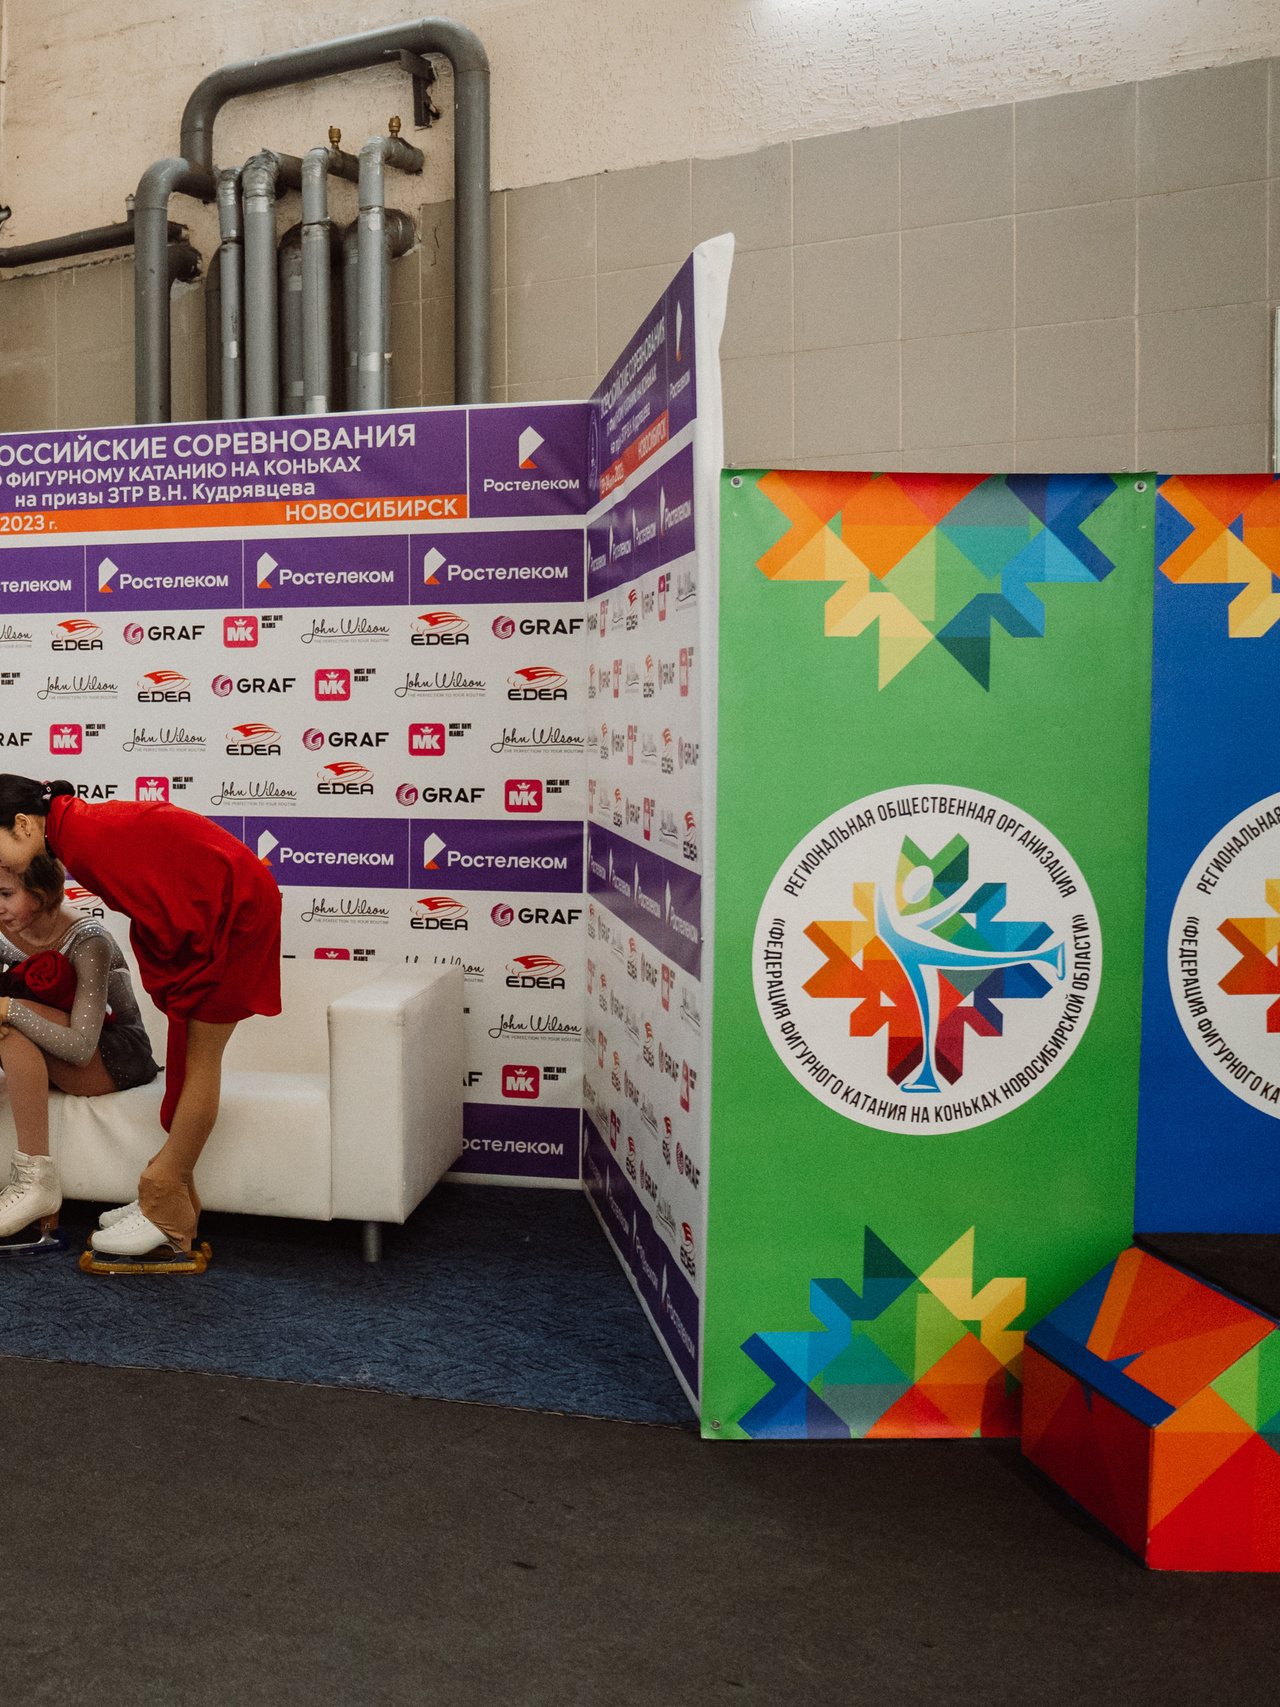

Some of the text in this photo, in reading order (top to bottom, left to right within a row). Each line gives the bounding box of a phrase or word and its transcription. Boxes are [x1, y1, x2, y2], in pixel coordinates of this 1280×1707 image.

[173, 423, 415, 460] СОРЕВНОВАНИЯ
[6, 467, 124, 488] ФИГУРНОМУ
[129, 462, 227, 482] КАТАНИЮ
[231, 460, 266, 477] НА
[268, 456, 361, 476] КОНЬКАХ
[484, 478, 579, 492] Ростелеком
[15, 482, 315, 510] на призы ЗТР В.Н. Кудрявцева
[285, 497, 459, 522] НОВОСИБИРСК
[0, 514, 45, 532] 2023
[49, 521, 57, 530] г.
[279, 569, 394, 585] Ростелеком
[448, 564, 568, 581] Ростелеком
[120, 574, 228, 589] Ростелеком
[148, 625, 205, 641] GRAF
[227, 627, 254, 641] MK
[300, 617, 390, 644] John Wilson
[519, 618, 584, 635] GRAF
[51, 639, 103, 651] EDEA
[411, 633, 469, 646] EDEA
[237, 678, 296, 693] GRAF
[318, 680, 346, 694] MK
[394, 671, 486, 698] John Wilson
[137, 691, 191, 703] EDEA
[507, 688, 567, 701] EDEA
[53, 735, 78, 748] MK
[328, 732, 389, 747] GRAF
[412, 734, 440, 749] MK
[490, 726, 584, 753] John Wilson
[226, 744, 281, 756] EDEA
[317, 782, 374, 795] EDEA
[422, 787, 485, 803] GRAF
[509, 791, 537, 806] MK
[783, 796, 1077, 899] РЕГИОНАЛЬНАЯ ОБЩЕСТВЕННАЯ ОРГАНИЗАЦИЯ
[280, 847, 394, 865] Ростелеком
[447, 850, 567, 869] Ростелеком
[410, 917, 468, 931] EDEA
[518, 908, 582, 925] GRAF
[506, 976, 565, 990] EDEA
[1178, 916, 1208, 1019] «ФЕДЕРАЦИЯ
[1197, 1017, 1262, 1093] ФИГУРНОГО
[488, 1013, 583, 1038] John Wilson
[763, 913, 1092, 1124] «ФЕДЕРАЦИЯ ФИГУРНОГО КАТАНИЯ НА КОНЬКАХ НОВОСИБИРСКОЙ ОБЛАСТИ»
[506, 1076, 535, 1092] MK
[463, 1137, 565, 1157] остелеком
